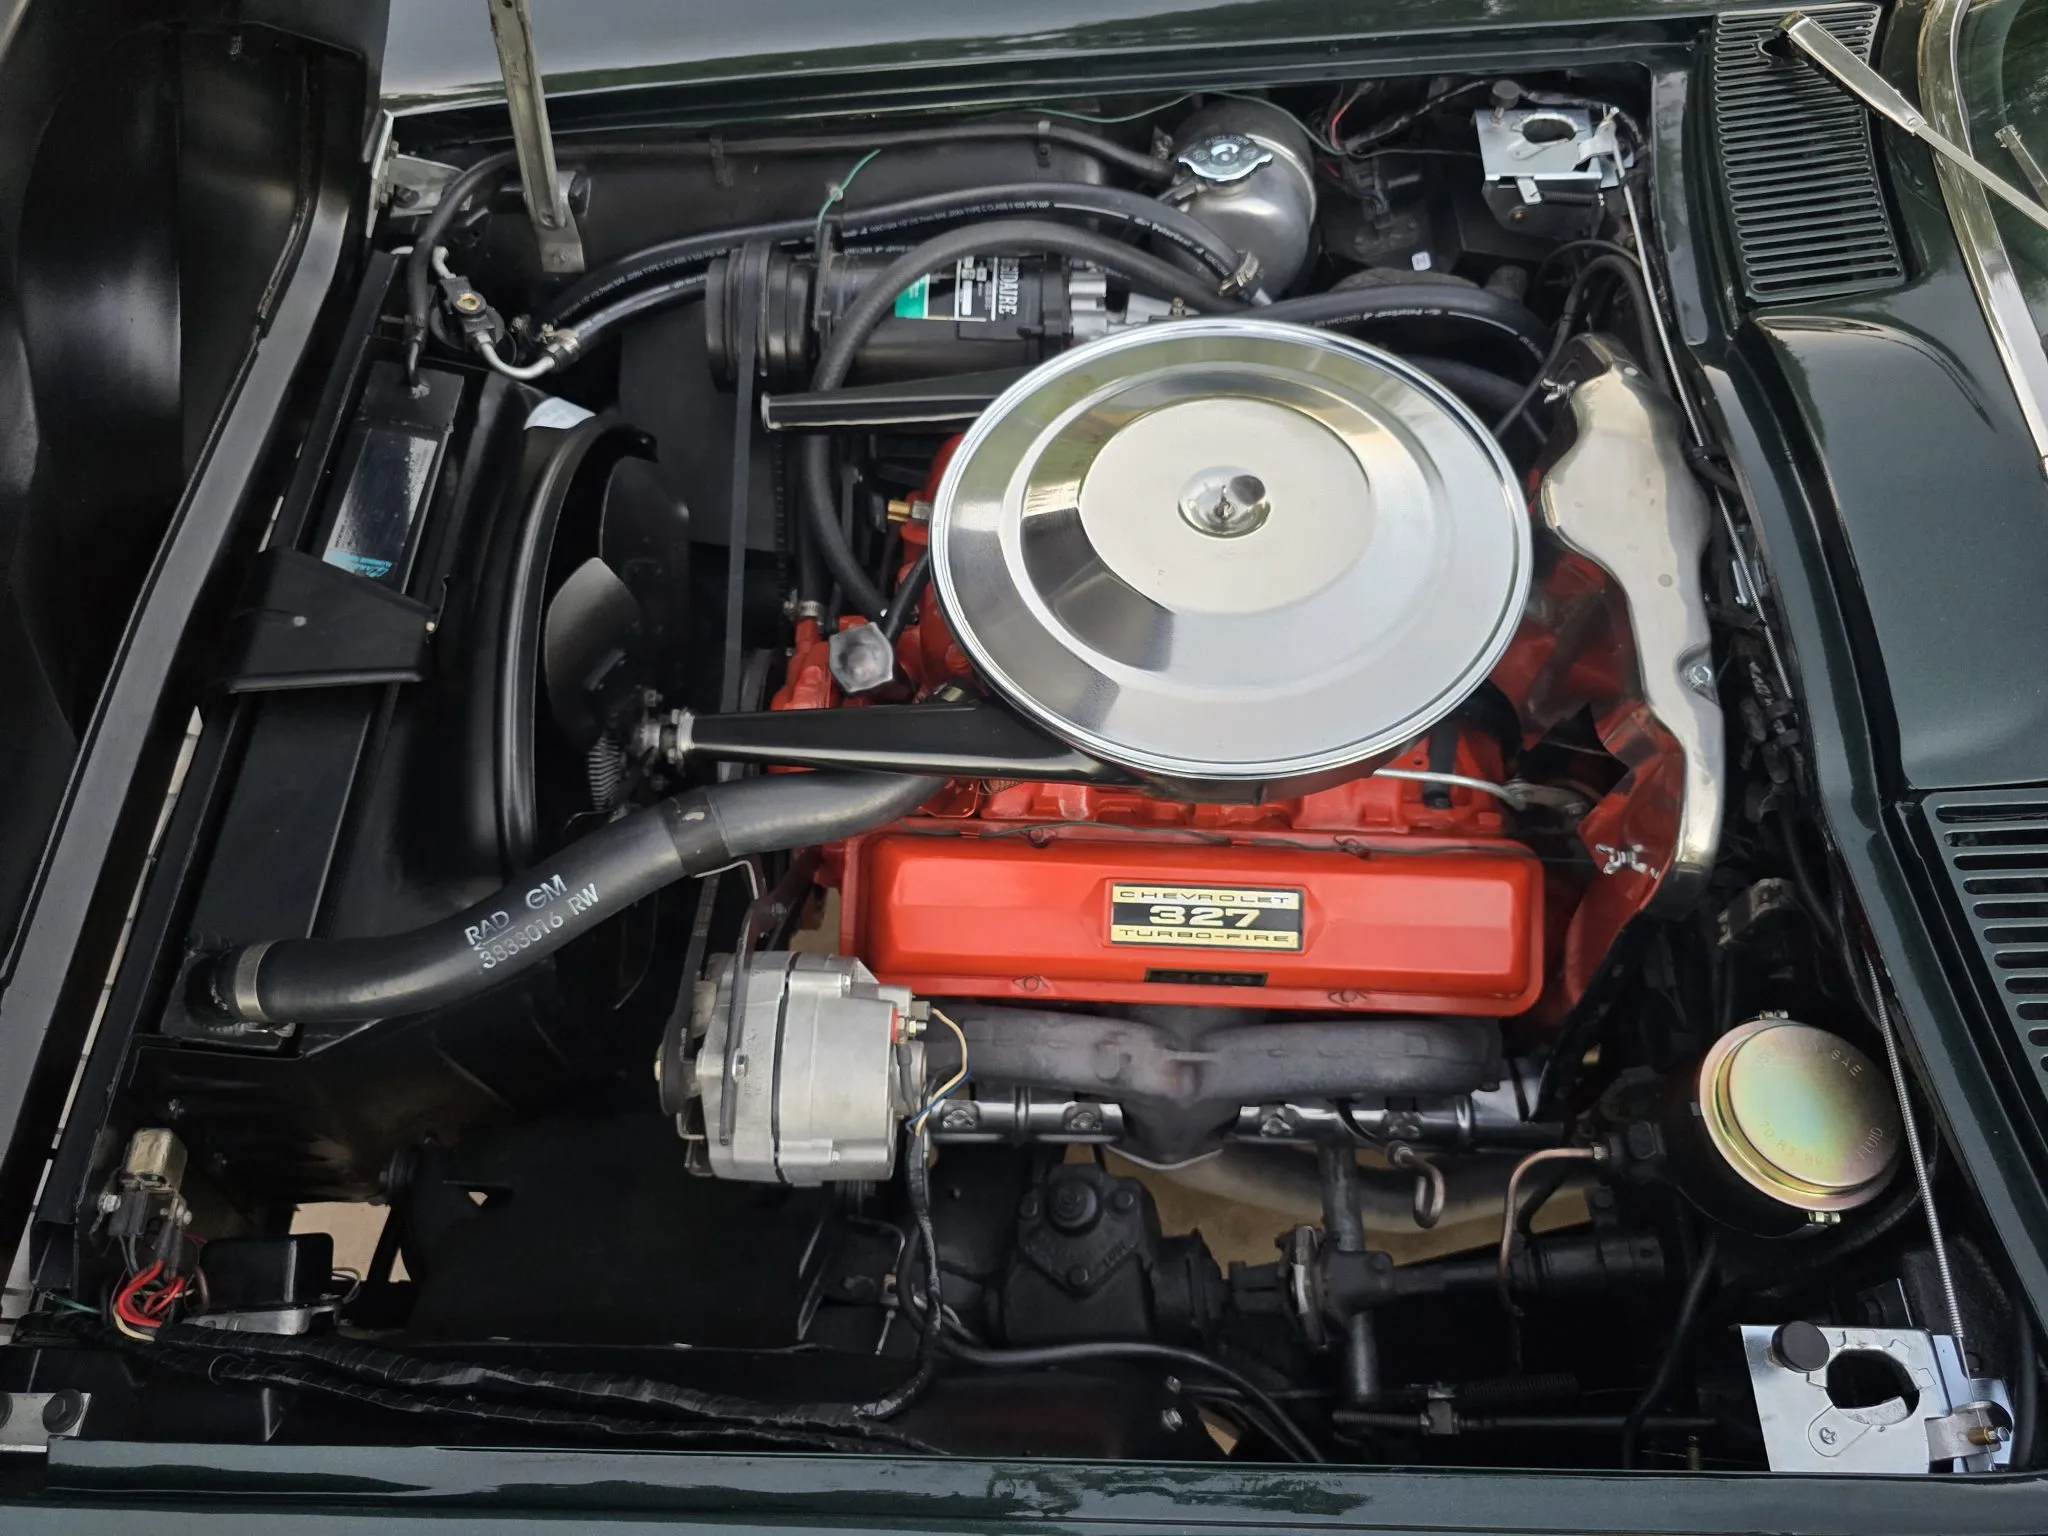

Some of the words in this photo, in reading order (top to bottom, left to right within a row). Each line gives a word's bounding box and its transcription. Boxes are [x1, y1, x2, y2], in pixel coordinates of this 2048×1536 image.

[464, 910, 510, 945] RAD
[525, 873, 567, 909] GM
[1119, 890, 1289, 904] CHEVROLET
[479, 911, 564, 969] 3833016
[567, 882, 600, 915] RW
[1149, 905, 1261, 928] 327
[1119, 929, 1289, 942] TURBO-FIRE
[1831, 1049, 1862, 1077] SAE
